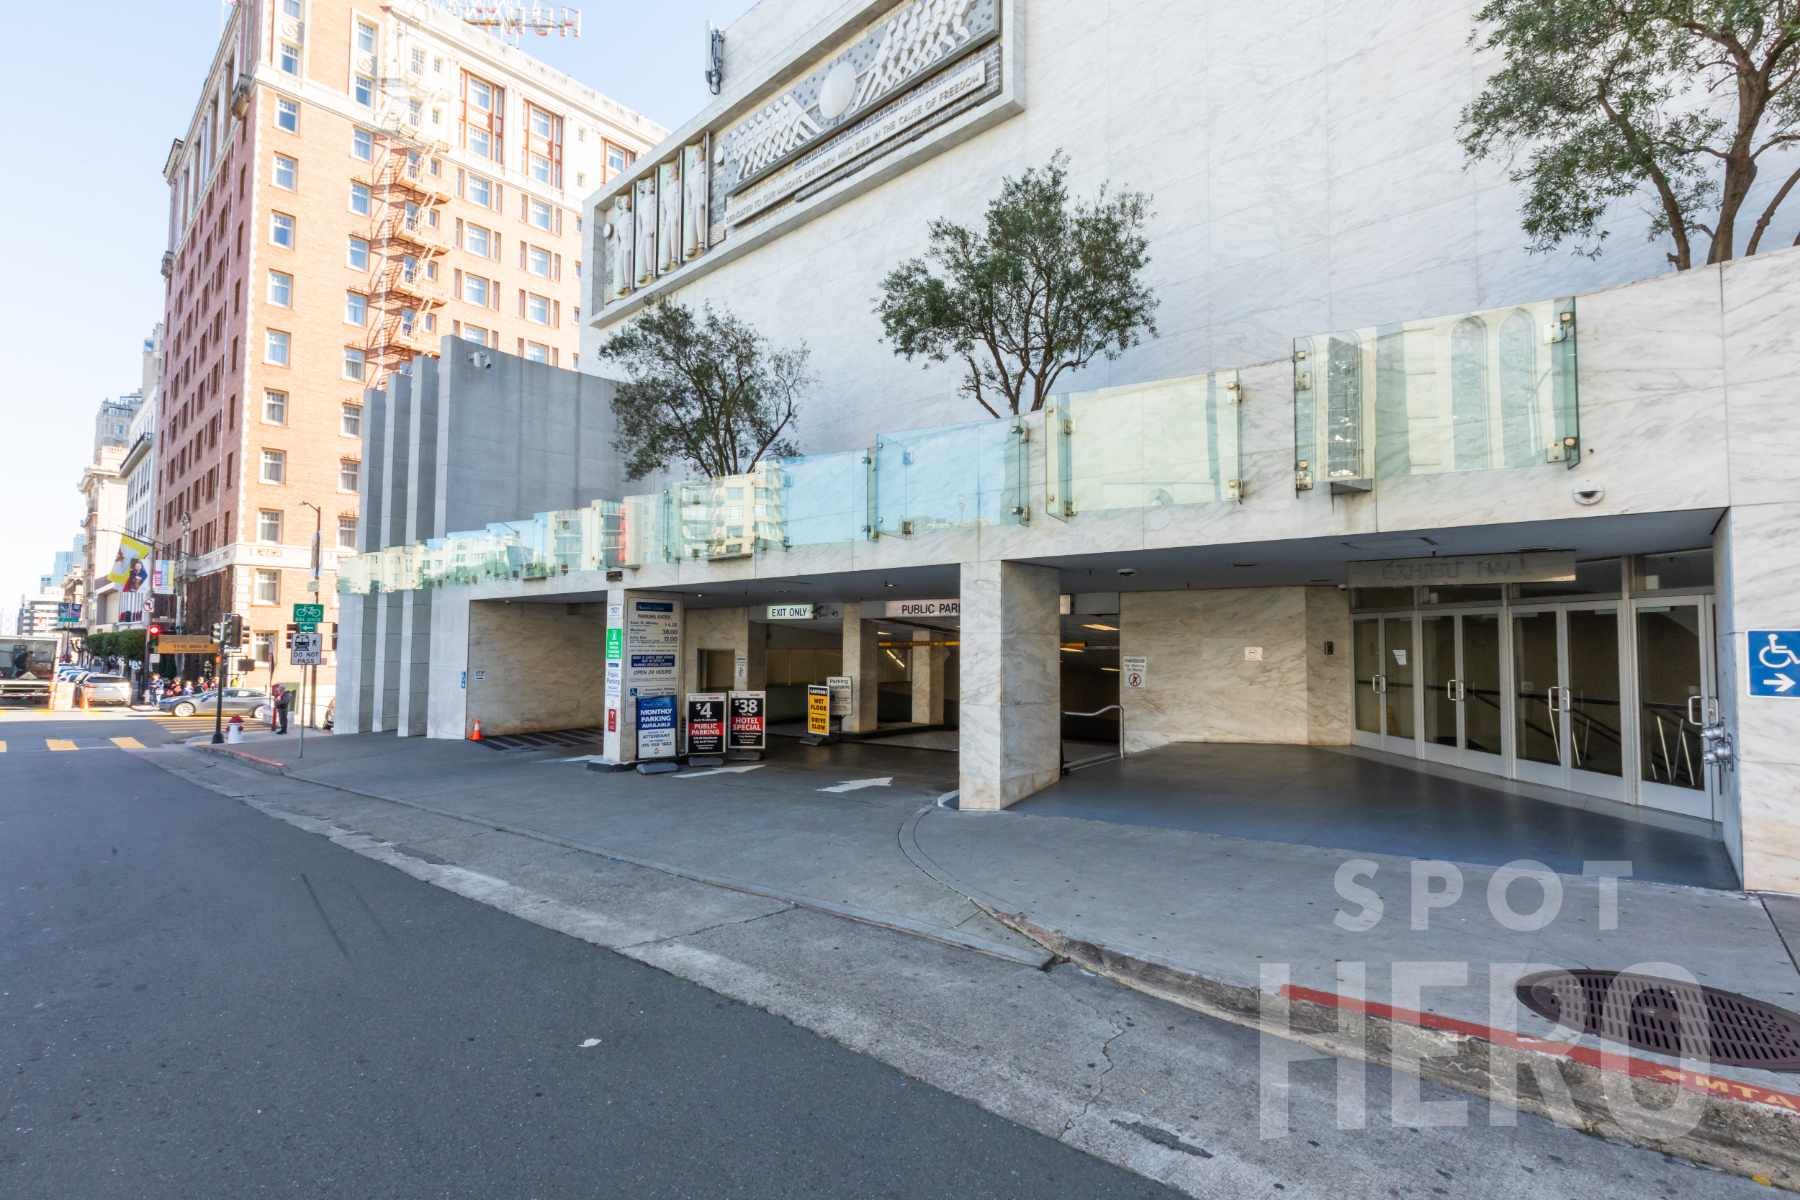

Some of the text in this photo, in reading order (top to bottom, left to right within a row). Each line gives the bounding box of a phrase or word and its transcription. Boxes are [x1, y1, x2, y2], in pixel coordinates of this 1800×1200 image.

[726, 72, 980, 224] DEDICATED TO OUR MASONIC BRETHREN WHO DIED IN THE CAUSE OF FREEDOM
[772, 608, 807, 617] EXIT ONLY
[902, 604, 935, 614] PUBLIC
[696, 702, 712, 718] $4
[735, 700, 758, 713] $38
